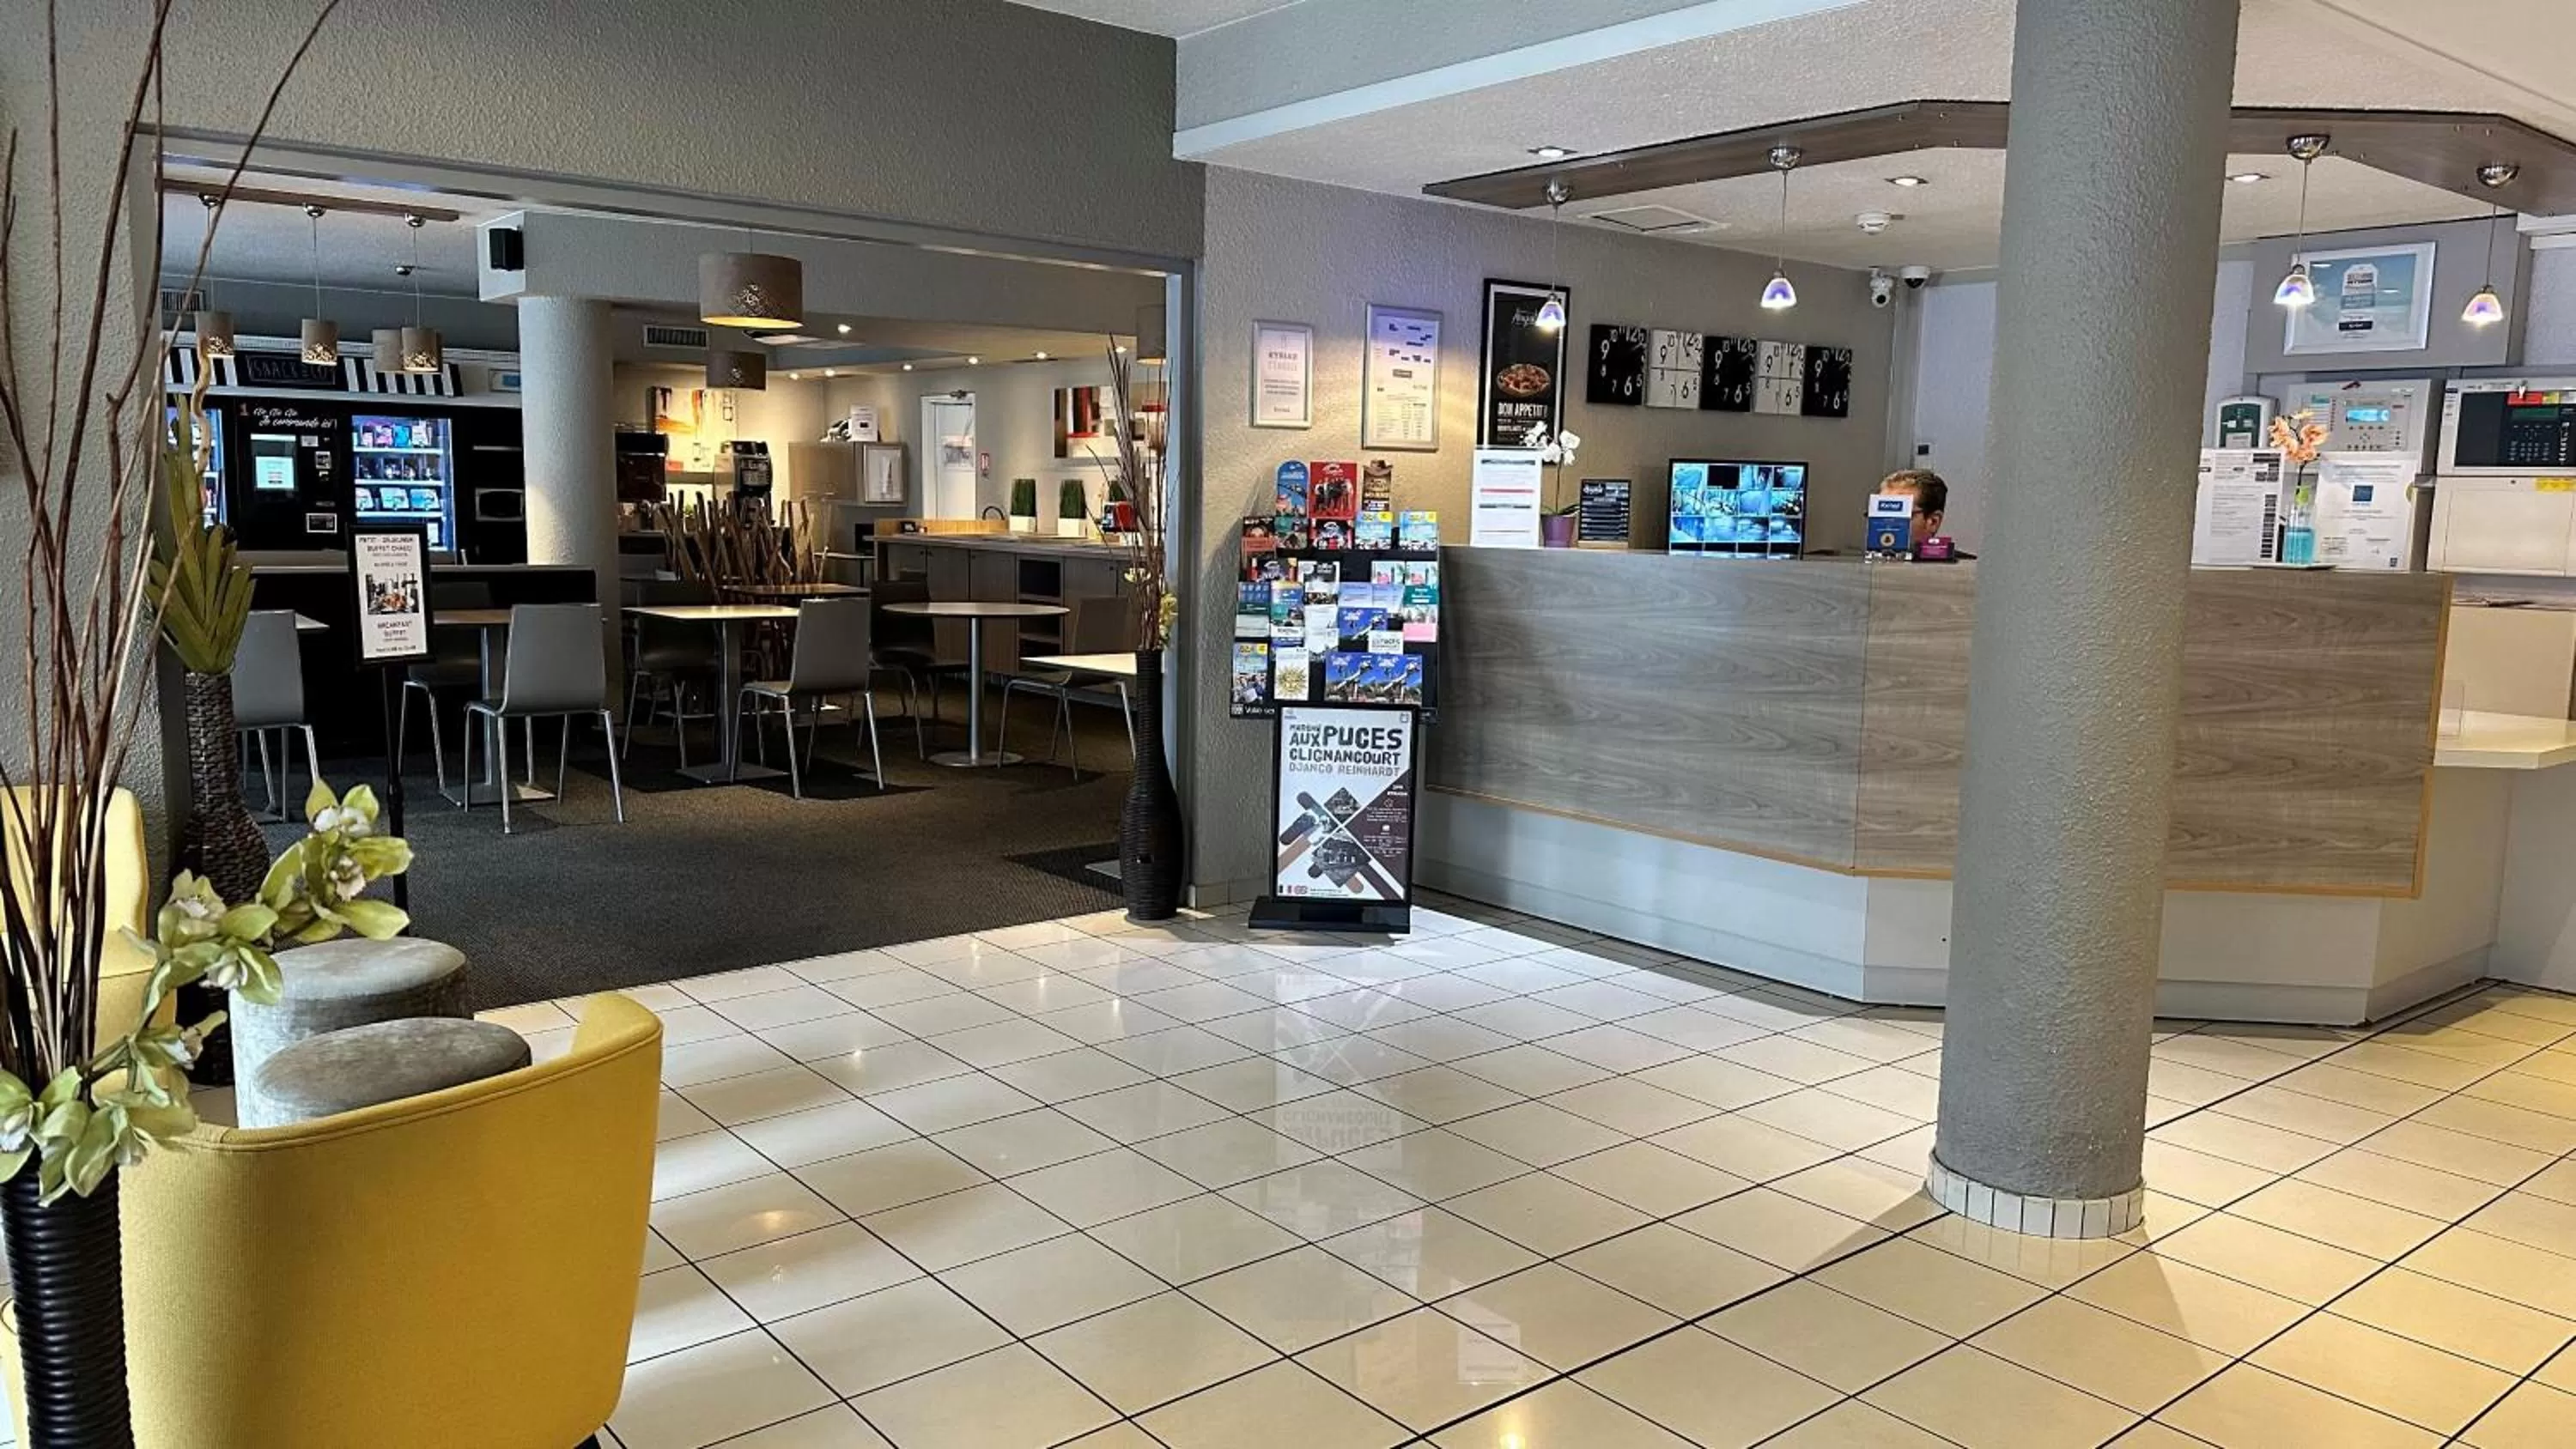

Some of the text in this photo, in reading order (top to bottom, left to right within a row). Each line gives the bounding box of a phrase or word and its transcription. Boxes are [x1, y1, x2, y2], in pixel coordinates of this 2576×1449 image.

[1601, 339, 1610, 360] 9
[1660, 344, 1668, 365] 9
[1715, 349, 1723, 369] 9
[1765, 355, 1773, 373] 9
[1814, 359, 1822, 378] 9
[1624, 376, 1632, 395] 6
[1680, 380, 1690, 399] 6
[1734, 385, 1742, 403] 6
[1785, 389, 1792, 407] 6
[1833, 391, 1840, 410] 6
[1290, 724, 1403, 750] AUX PUCES
[1289, 747, 1401, 766] CLIGNANCOURT
[1290, 761, 1400, 777] DJANGO REINHARDT
